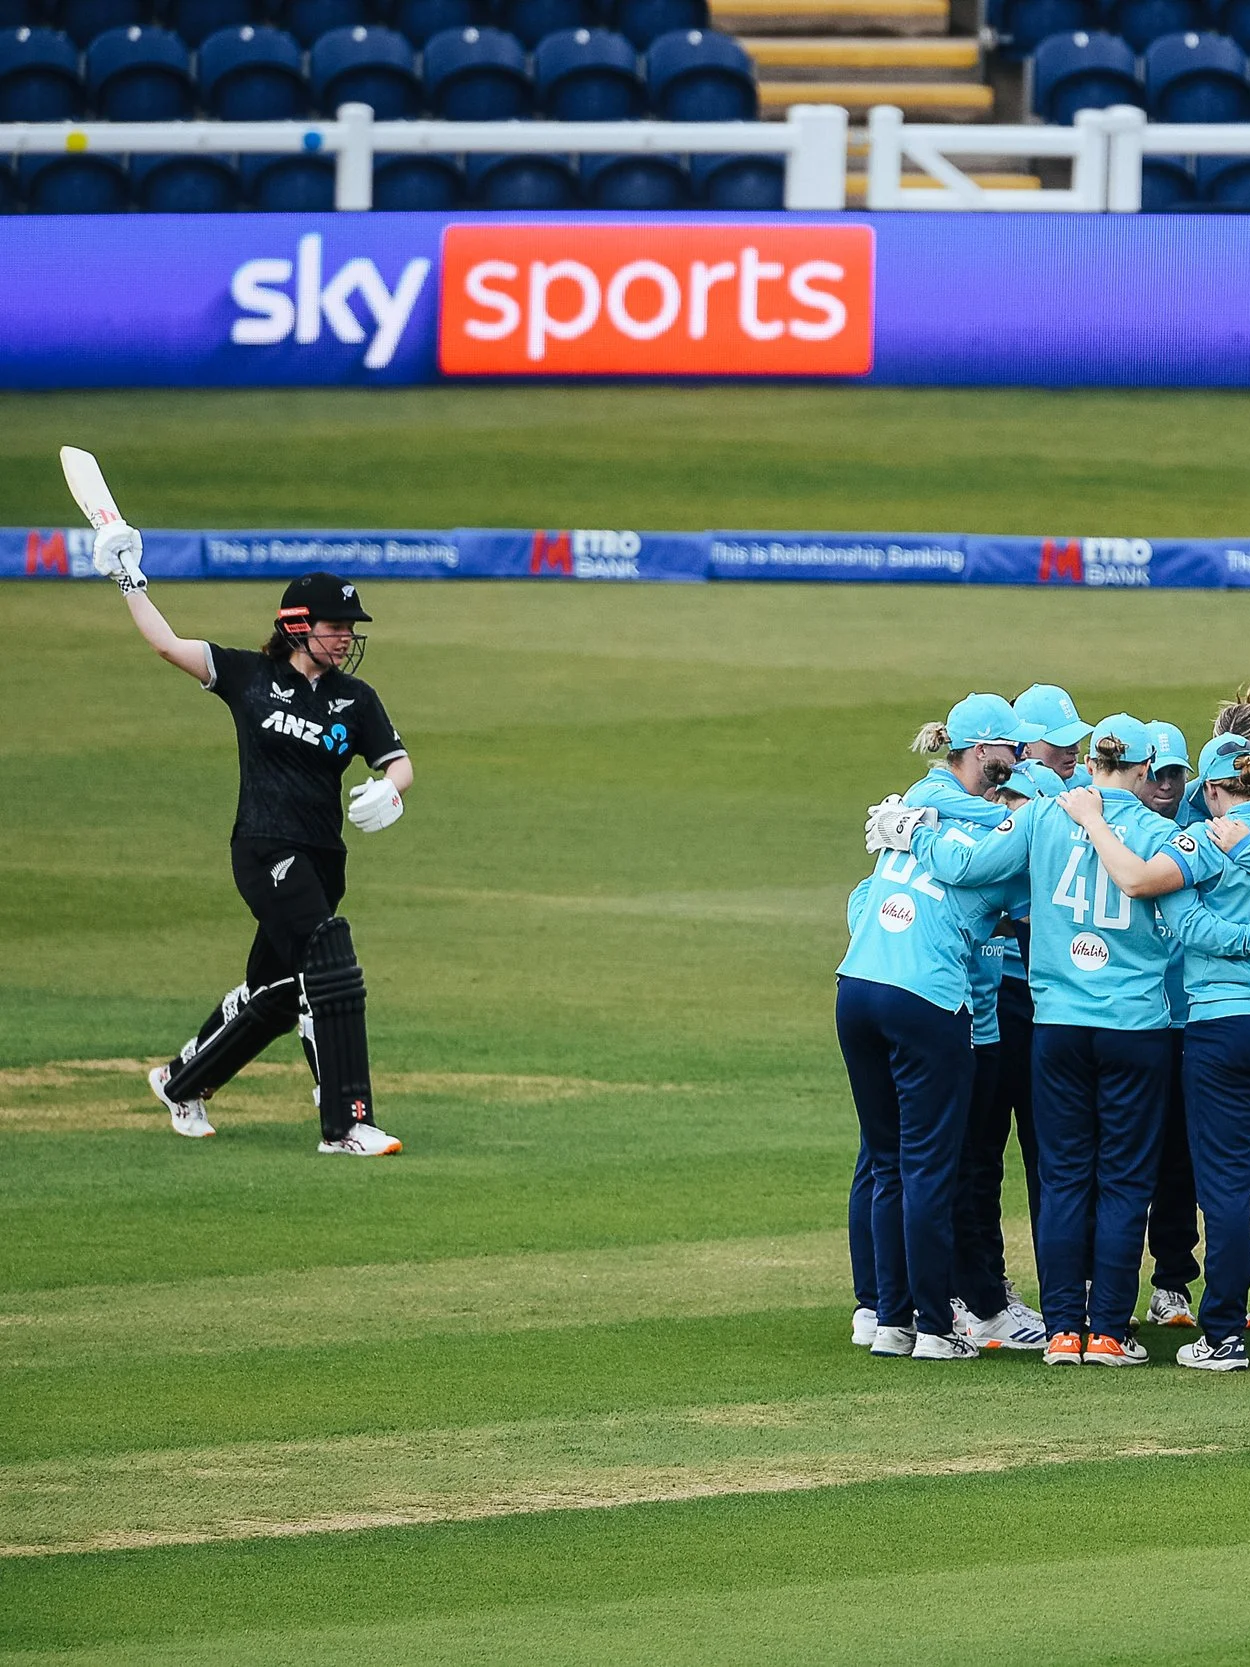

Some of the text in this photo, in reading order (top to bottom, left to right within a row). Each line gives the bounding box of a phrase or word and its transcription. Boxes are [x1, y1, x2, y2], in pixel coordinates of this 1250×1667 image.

[231, 232, 848, 368] sky sports
[210, 541, 458, 568] This is Relationship Banking
[575, 557, 639, 578] BANK
[710, 543, 962, 573] This is Relationship Banking
[1085, 565, 1150, 585] BANK
[261, 710, 323, 746] ANZ
[1052, 846, 1131, 930] 40
[881, 901, 913, 924] Vitality
[1072, 940, 1108, 961] Vitality
